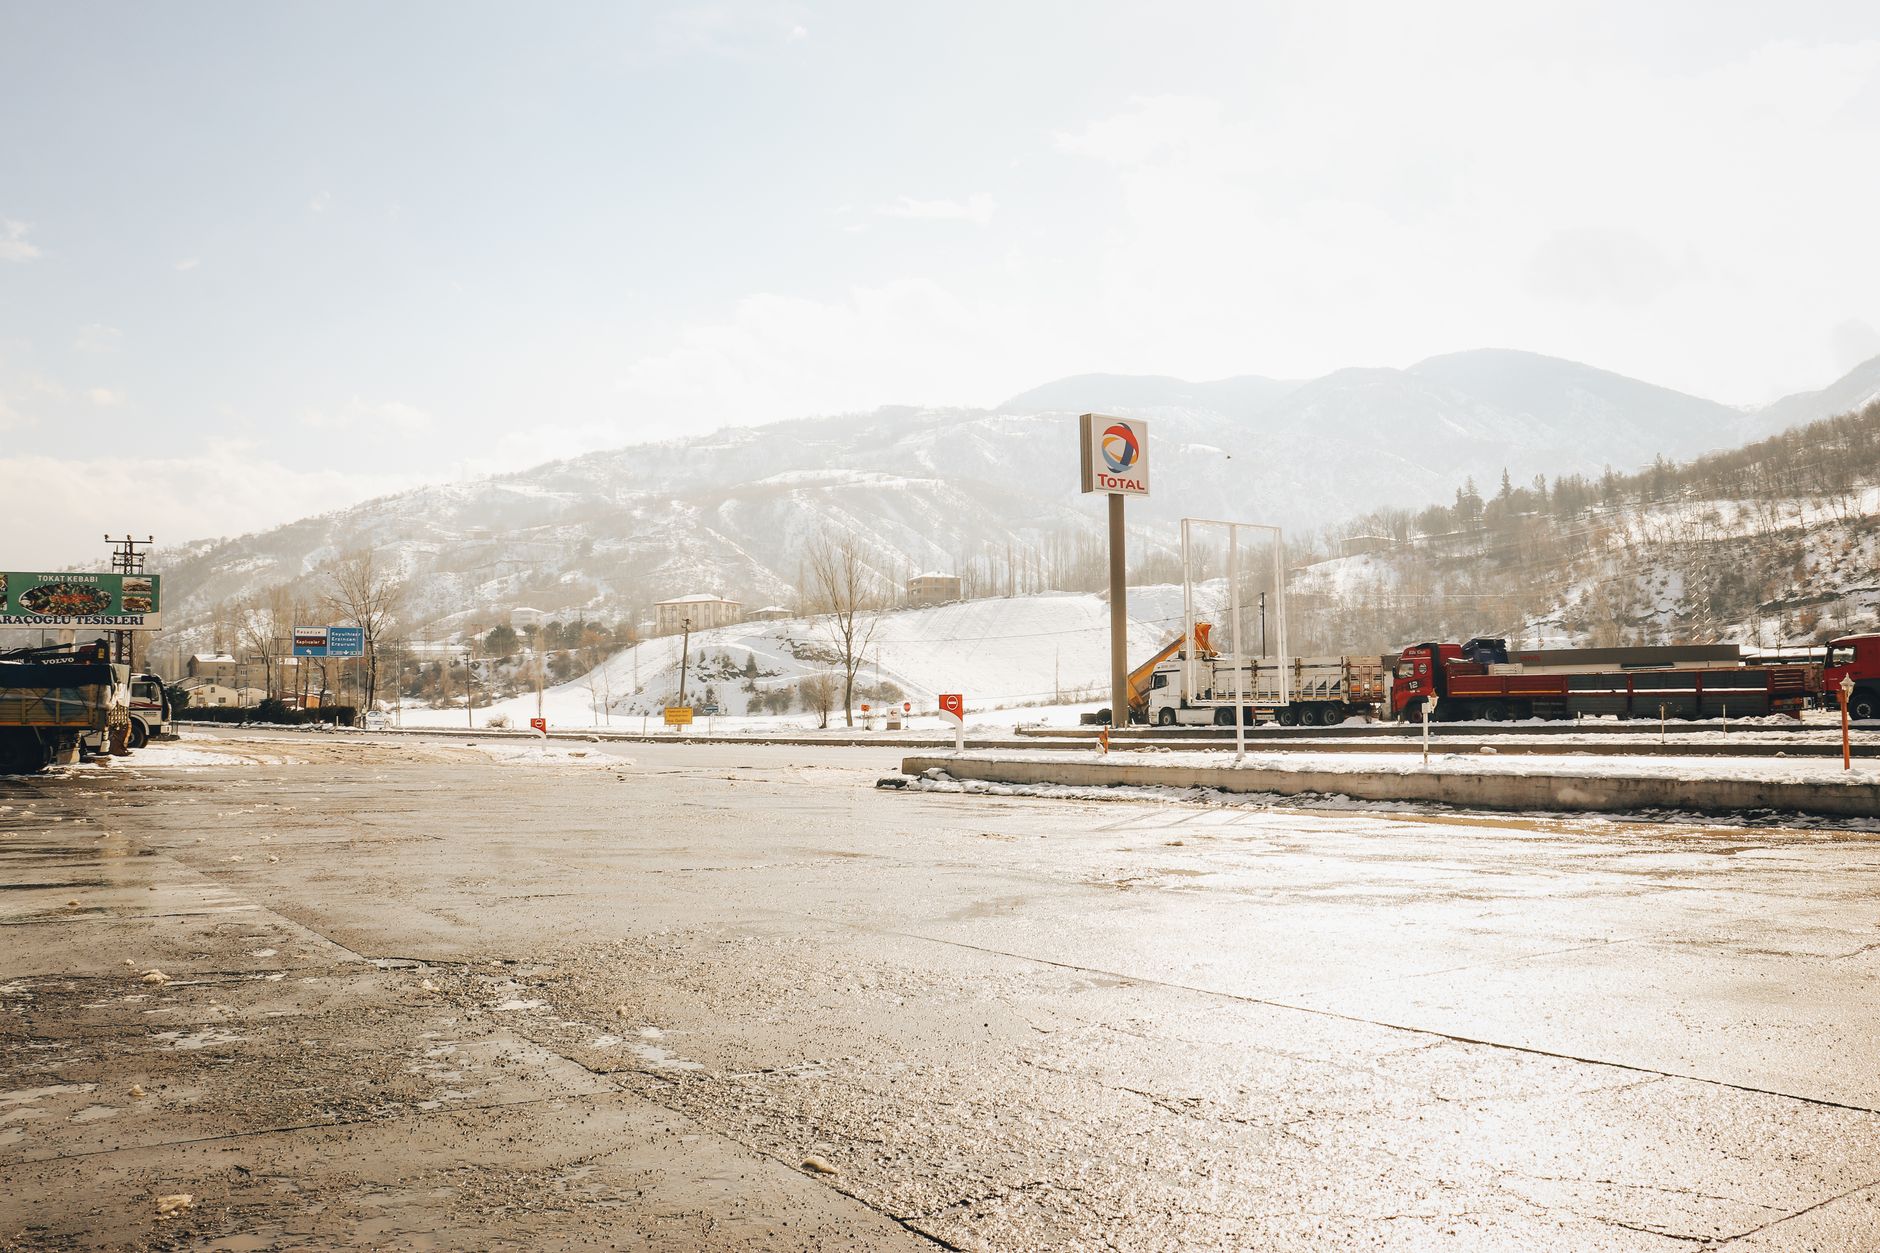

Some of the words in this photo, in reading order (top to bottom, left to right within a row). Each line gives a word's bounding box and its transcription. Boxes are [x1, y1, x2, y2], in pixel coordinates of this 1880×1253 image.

[1097, 473, 1145, 490] TOTAL
[41, 657, 75, 665] VOLVO
[1408, 680, 1418, 690] 12
